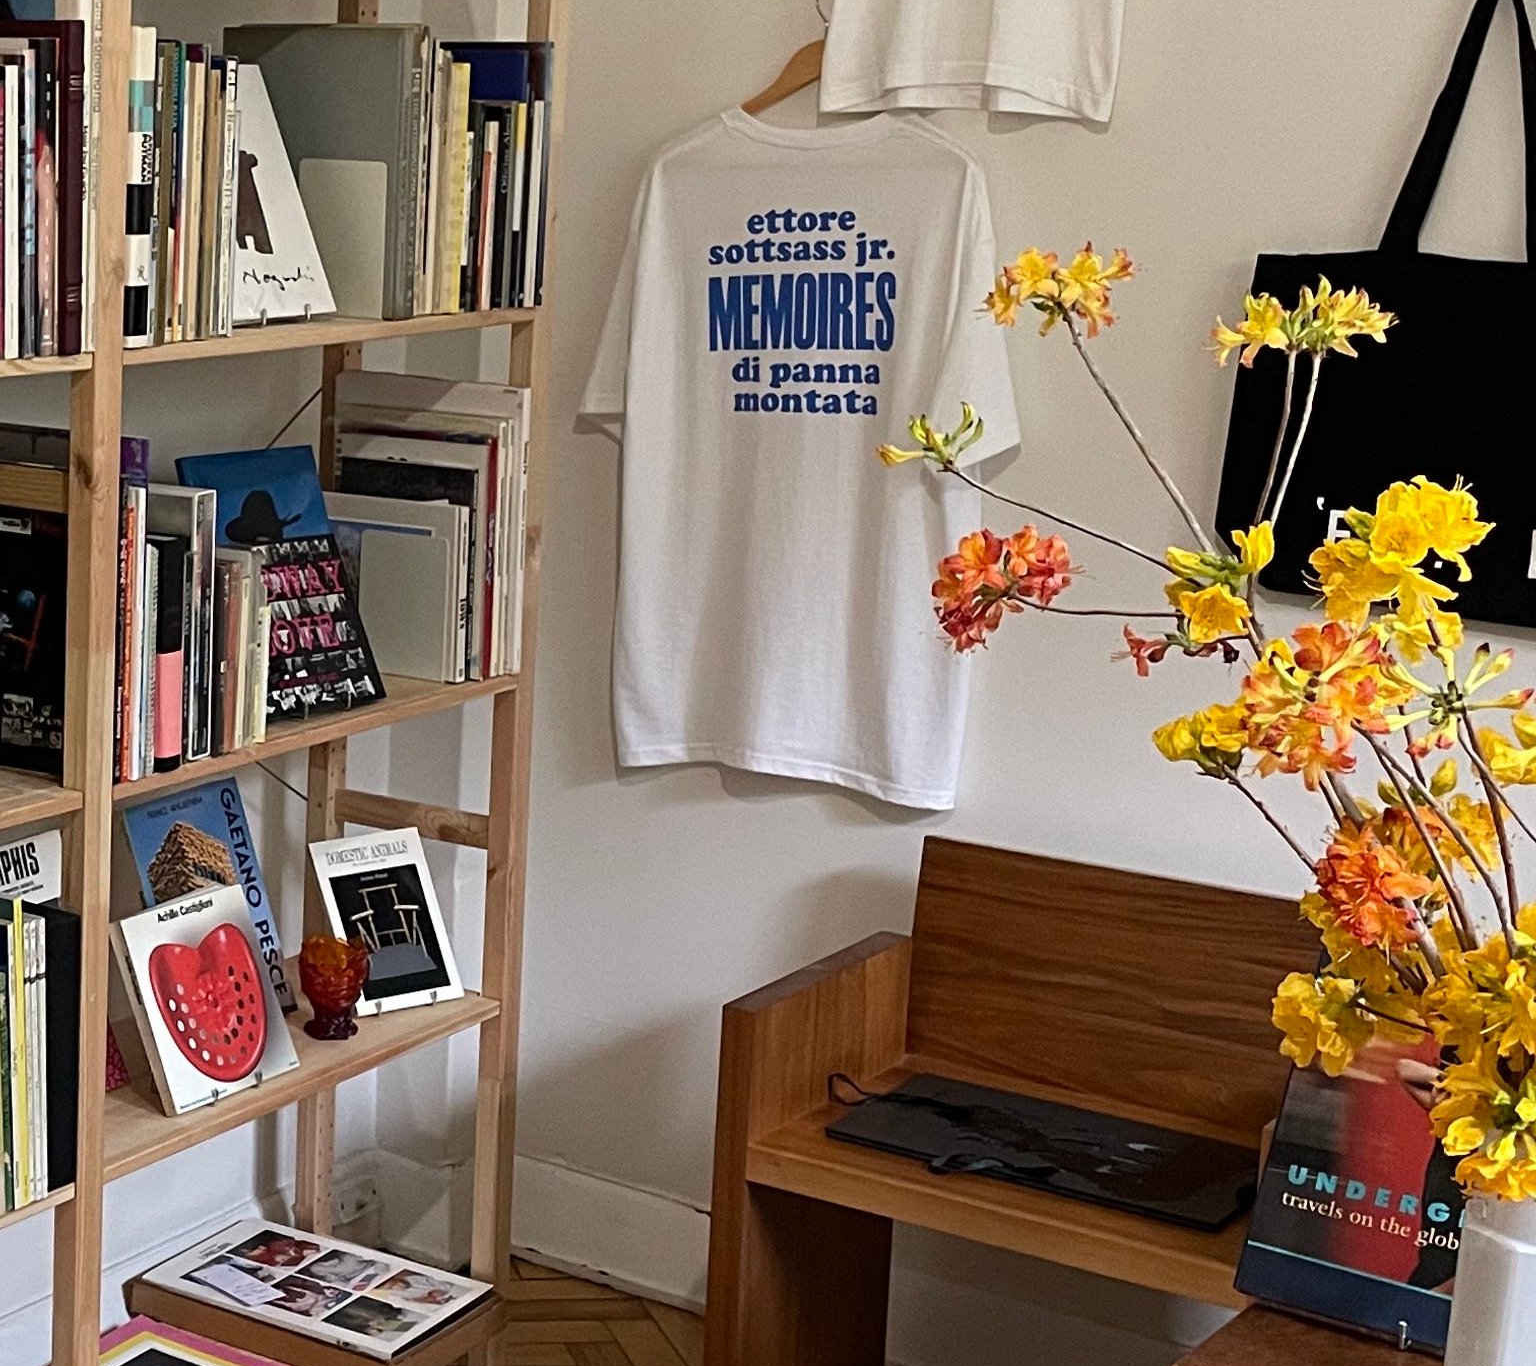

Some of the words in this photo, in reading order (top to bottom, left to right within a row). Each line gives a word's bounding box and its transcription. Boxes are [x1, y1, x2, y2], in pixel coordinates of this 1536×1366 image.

[140, 134, 149, 183] PUTMAN
[747, 208, 856, 234] ettore
[708, 238, 846, 265] sottsass
[855, 232, 895, 266] jr.
[708, 272, 896, 352] MEMOIRES
[732, 356, 760, 383] di
[769, 362, 880, 388] panna
[734, 390, 878, 415] montata
[268, 613, 341, 657] OVE
[221, 787, 262, 908] GAETANO
[255, 919, 288, 996] PESCE
[1282, 1190, 1343, 1220] travels
[1349, 1209, 1373, 1228] on
[1380, 1217, 1411, 1238] the
